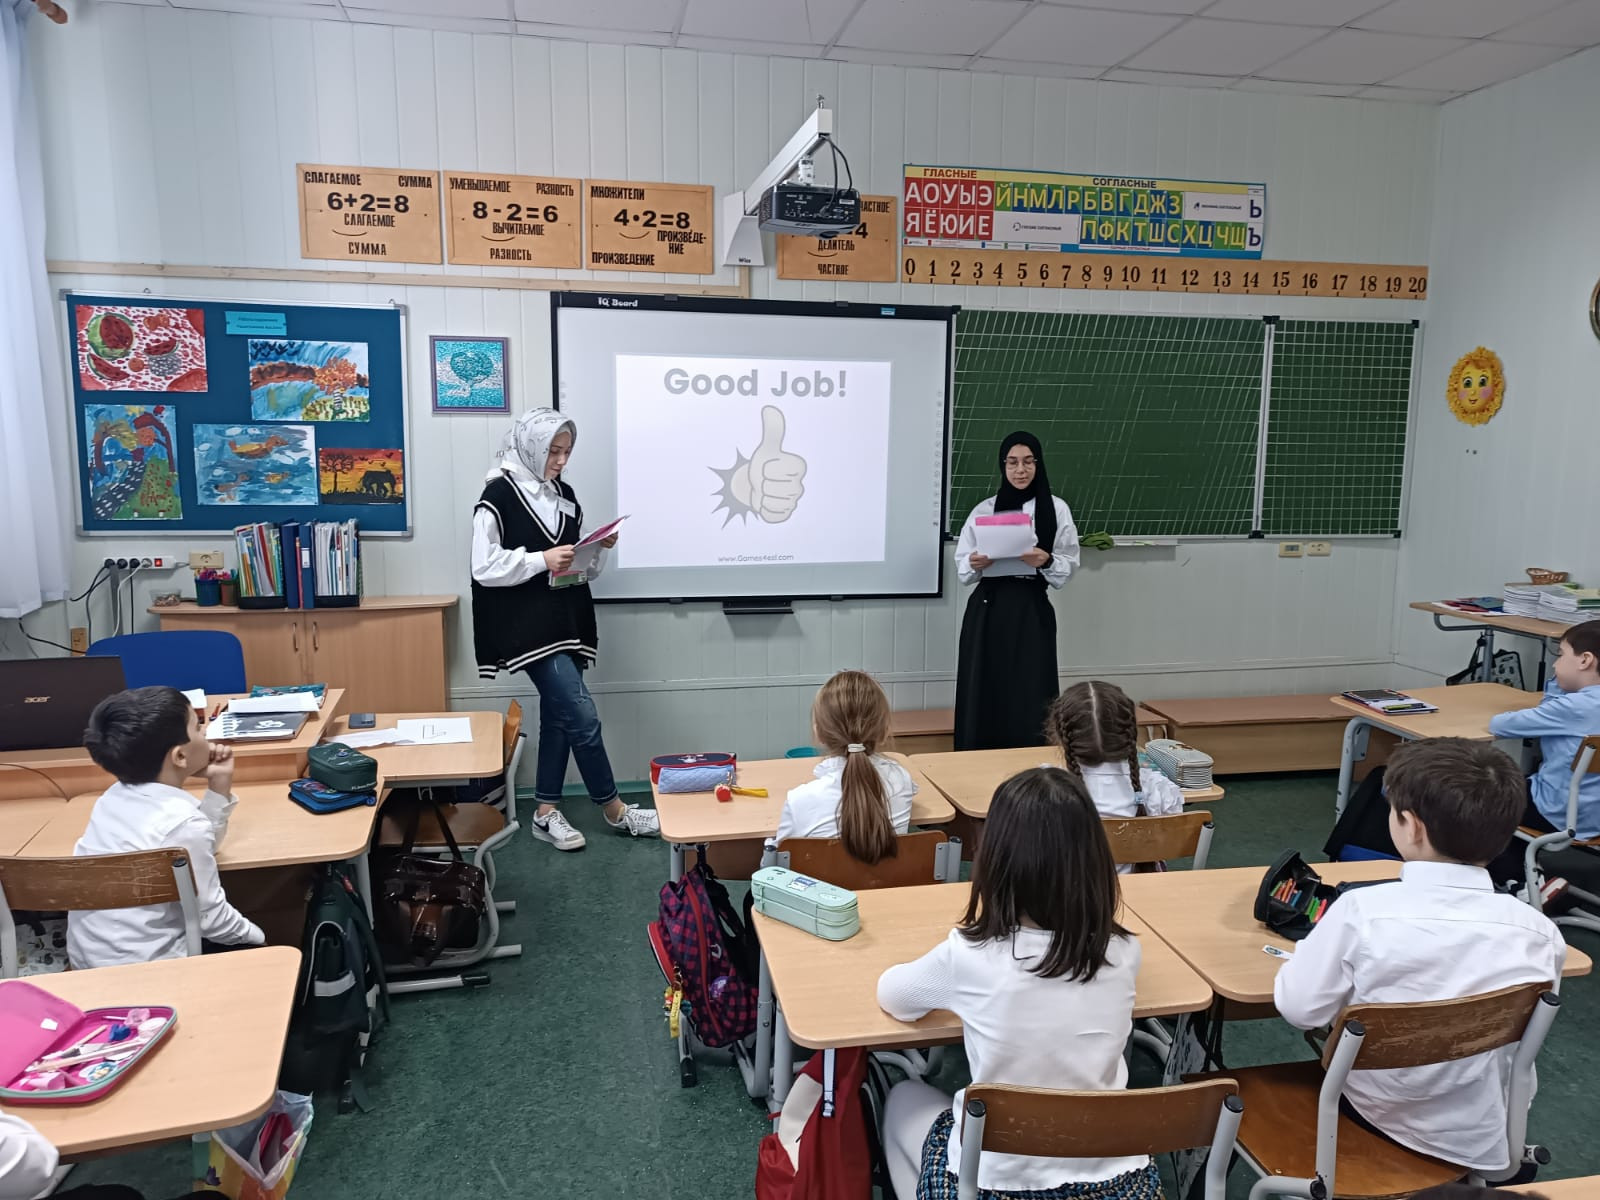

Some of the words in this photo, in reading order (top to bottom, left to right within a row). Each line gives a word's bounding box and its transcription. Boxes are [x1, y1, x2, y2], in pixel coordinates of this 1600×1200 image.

[304, 171, 362, 186] СЛАГАЕМОЕ
[923, 168, 977, 179] ГЛАСНЫЕ
[398, 175, 433, 189] СУММА
[449, 177, 511, 192] УМЕНЬШАЕМОЕ
[536, 182, 574, 196] РАЗНОСТЬ
[1092, 177, 1157, 189] СОГЛАСНЫЕ
[591, 185, 645, 200] МНОЖИТЕЛИ
[327, 192, 409, 213] 6+2=8
[344, 213, 396, 227] СЛАГАЕМОЕ
[492, 222, 544, 236] ВЫЧИТАЕМОЕ
[348, 242, 387, 255] СУММА
[668, 242, 684, 255] НИЕ
[818, 239, 855, 251] ДЕЛИТЕЛЬ
[490, 248, 532, 261] РАЗНОСТЬ
[591, 251, 655, 266] ПРОИЗВЕДЕНИЕ
[818, 263, 849, 275] ЧАСТНОЕ
[905, 258, 916, 276] 0
[929, 260, 936, 276] 1
[951, 260, 961, 277] 2
[973, 261, 983, 279] 3
[993, 262, 1003, 279] 4
[1017, 263, 1028, 280] 5
[1039, 264, 1049, 280] 6
[1061, 265, 1072, 281] 7
[1081, 265, 1092, 282] 8
[1103, 265, 1113, 282] 9
[1121, 265, 1141, 283] 10
[1151, 267, 1167, 284] 11
[1181, 269, 1199, 286] 12
[1213, 270, 1231, 288] 13
[1243, 271, 1259, 288] 14
[1272, 271, 1290, 287] 15
[1302, 273, 1318, 289] 16
[1331, 274, 1348, 290] 17
[1359, 275, 1377, 291] 18
[1385, 276, 1401, 292] 19
[1408, 277, 1427, 293] 20
[597, 296, 610, 307] IQ
[612, 299, 638, 307] Board
[664, 368, 758, 396] Good
[771, 370, 846, 397] Job!
